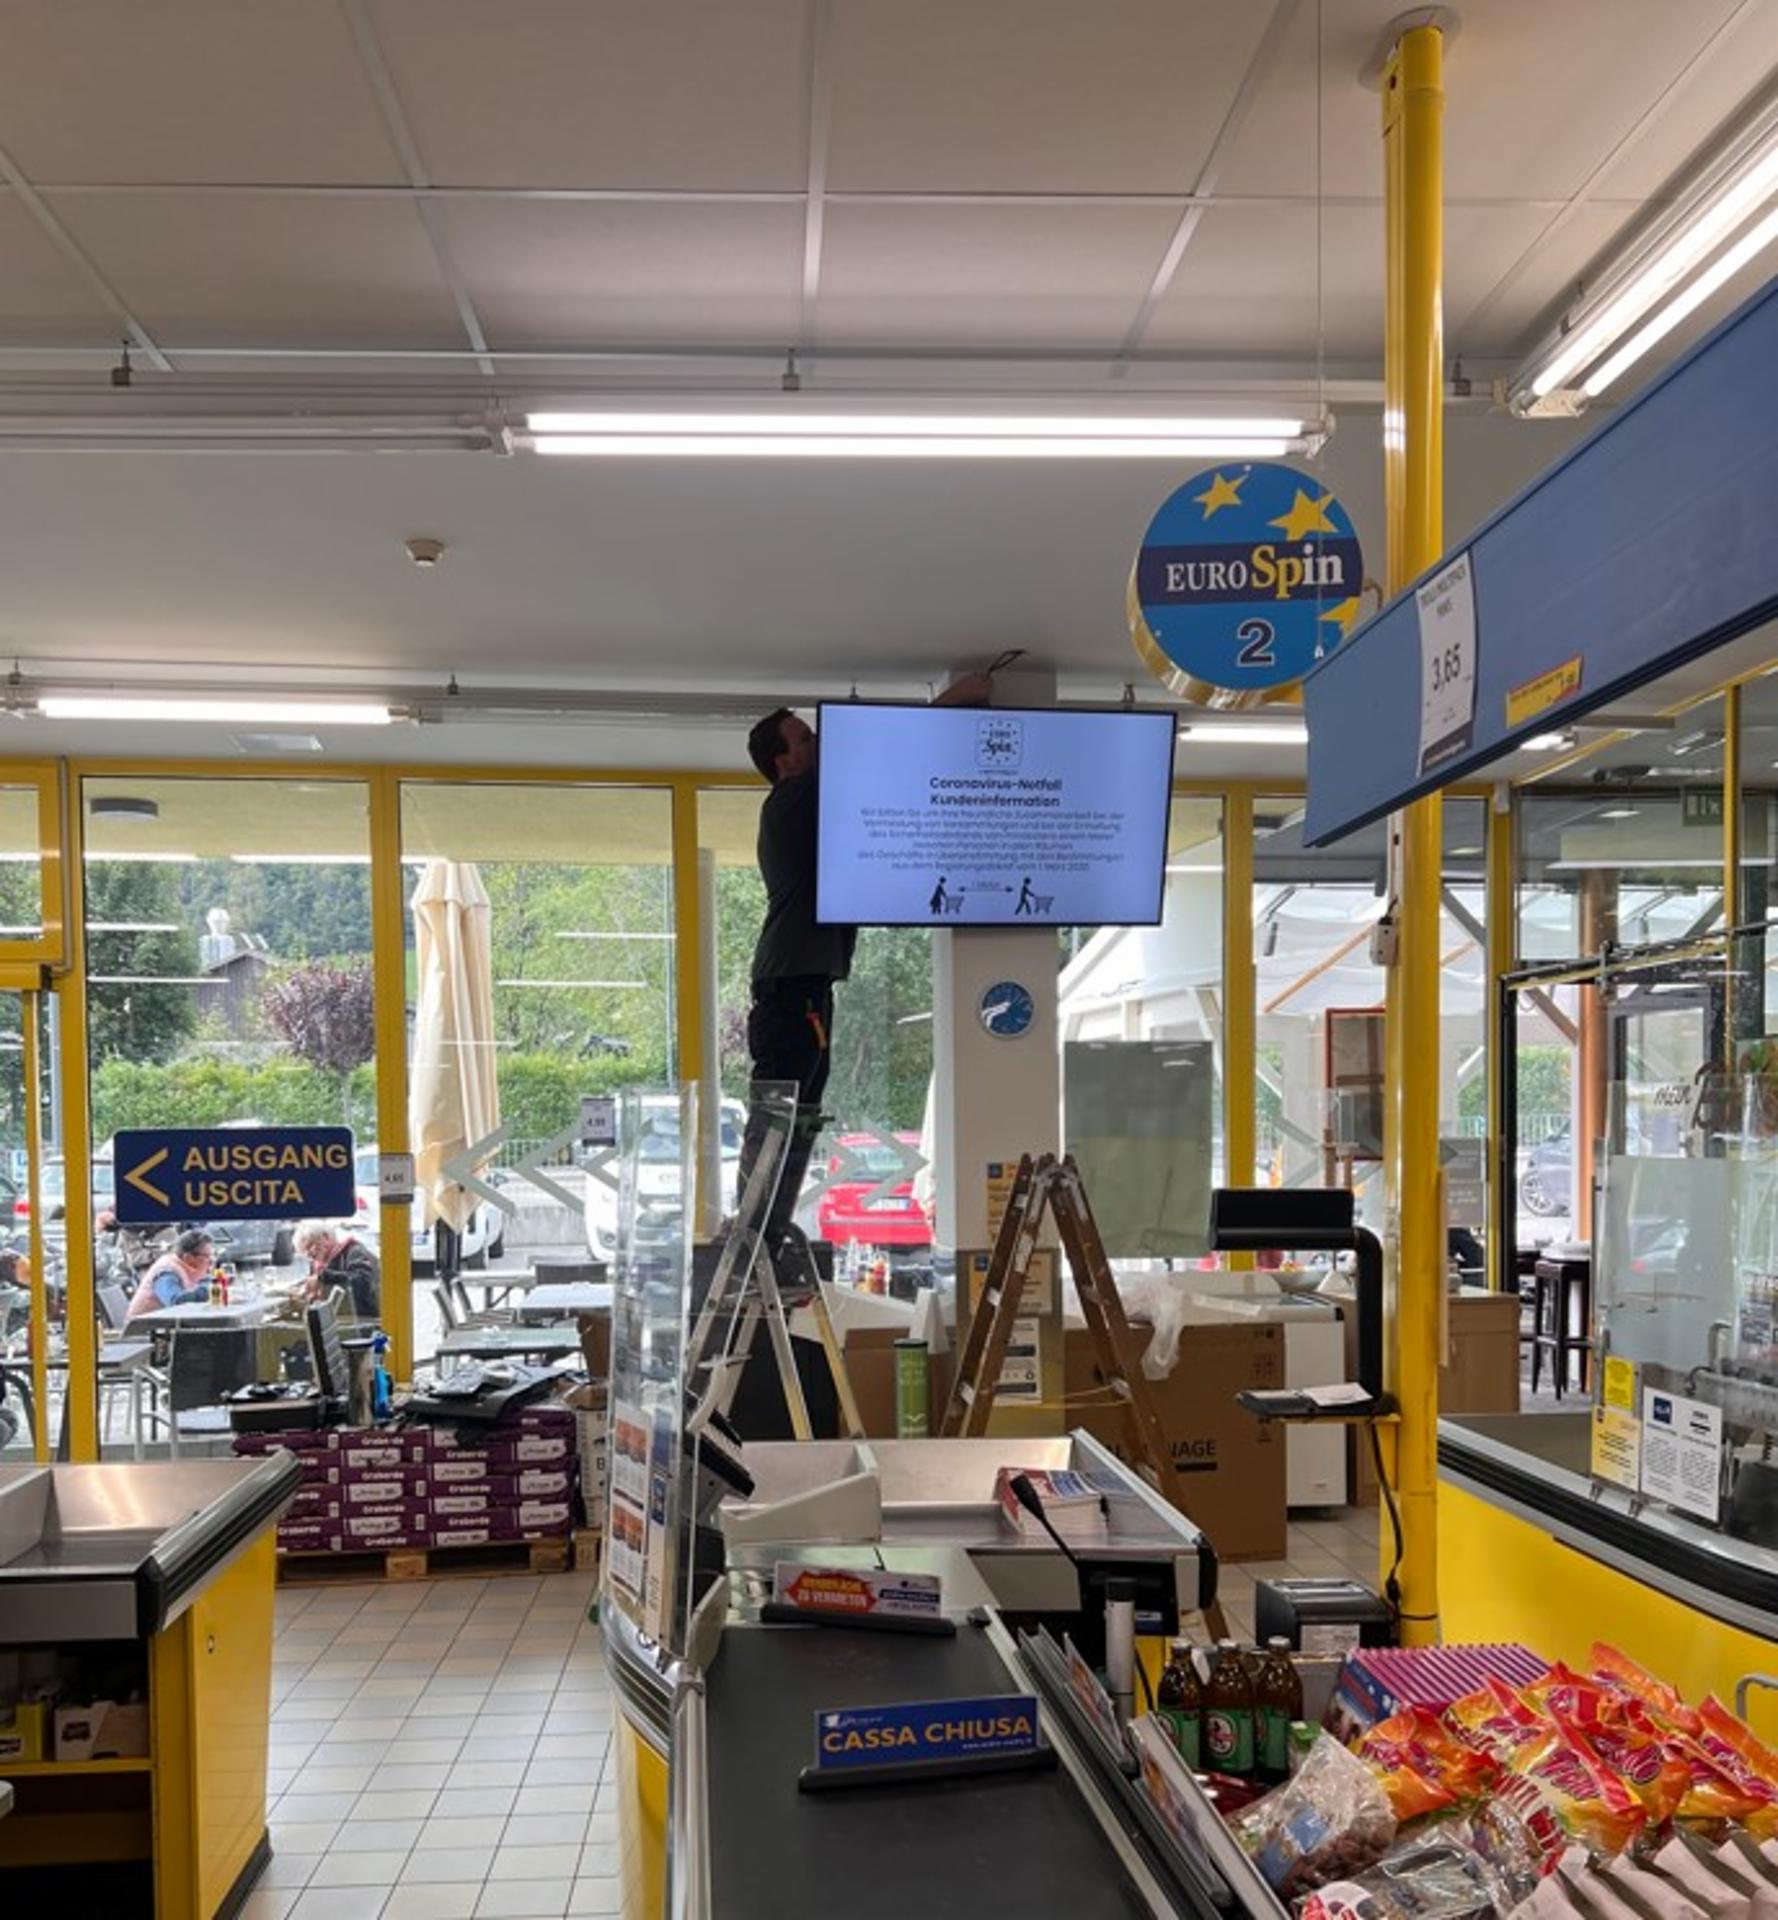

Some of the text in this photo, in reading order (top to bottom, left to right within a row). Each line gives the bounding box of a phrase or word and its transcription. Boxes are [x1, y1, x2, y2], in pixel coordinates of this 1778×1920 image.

[1236, 617, 1275, 667] 2
[930, 777, 1063, 791] Coronavirus-Notfall
[930, 794, 1060, 807] Kundeninformation
[183, 1144, 348, 1171] AUSGANG
[185, 1180, 304, 1206] USCITA
[822, 1715, 1032, 1754] CASSA CHIUSA
